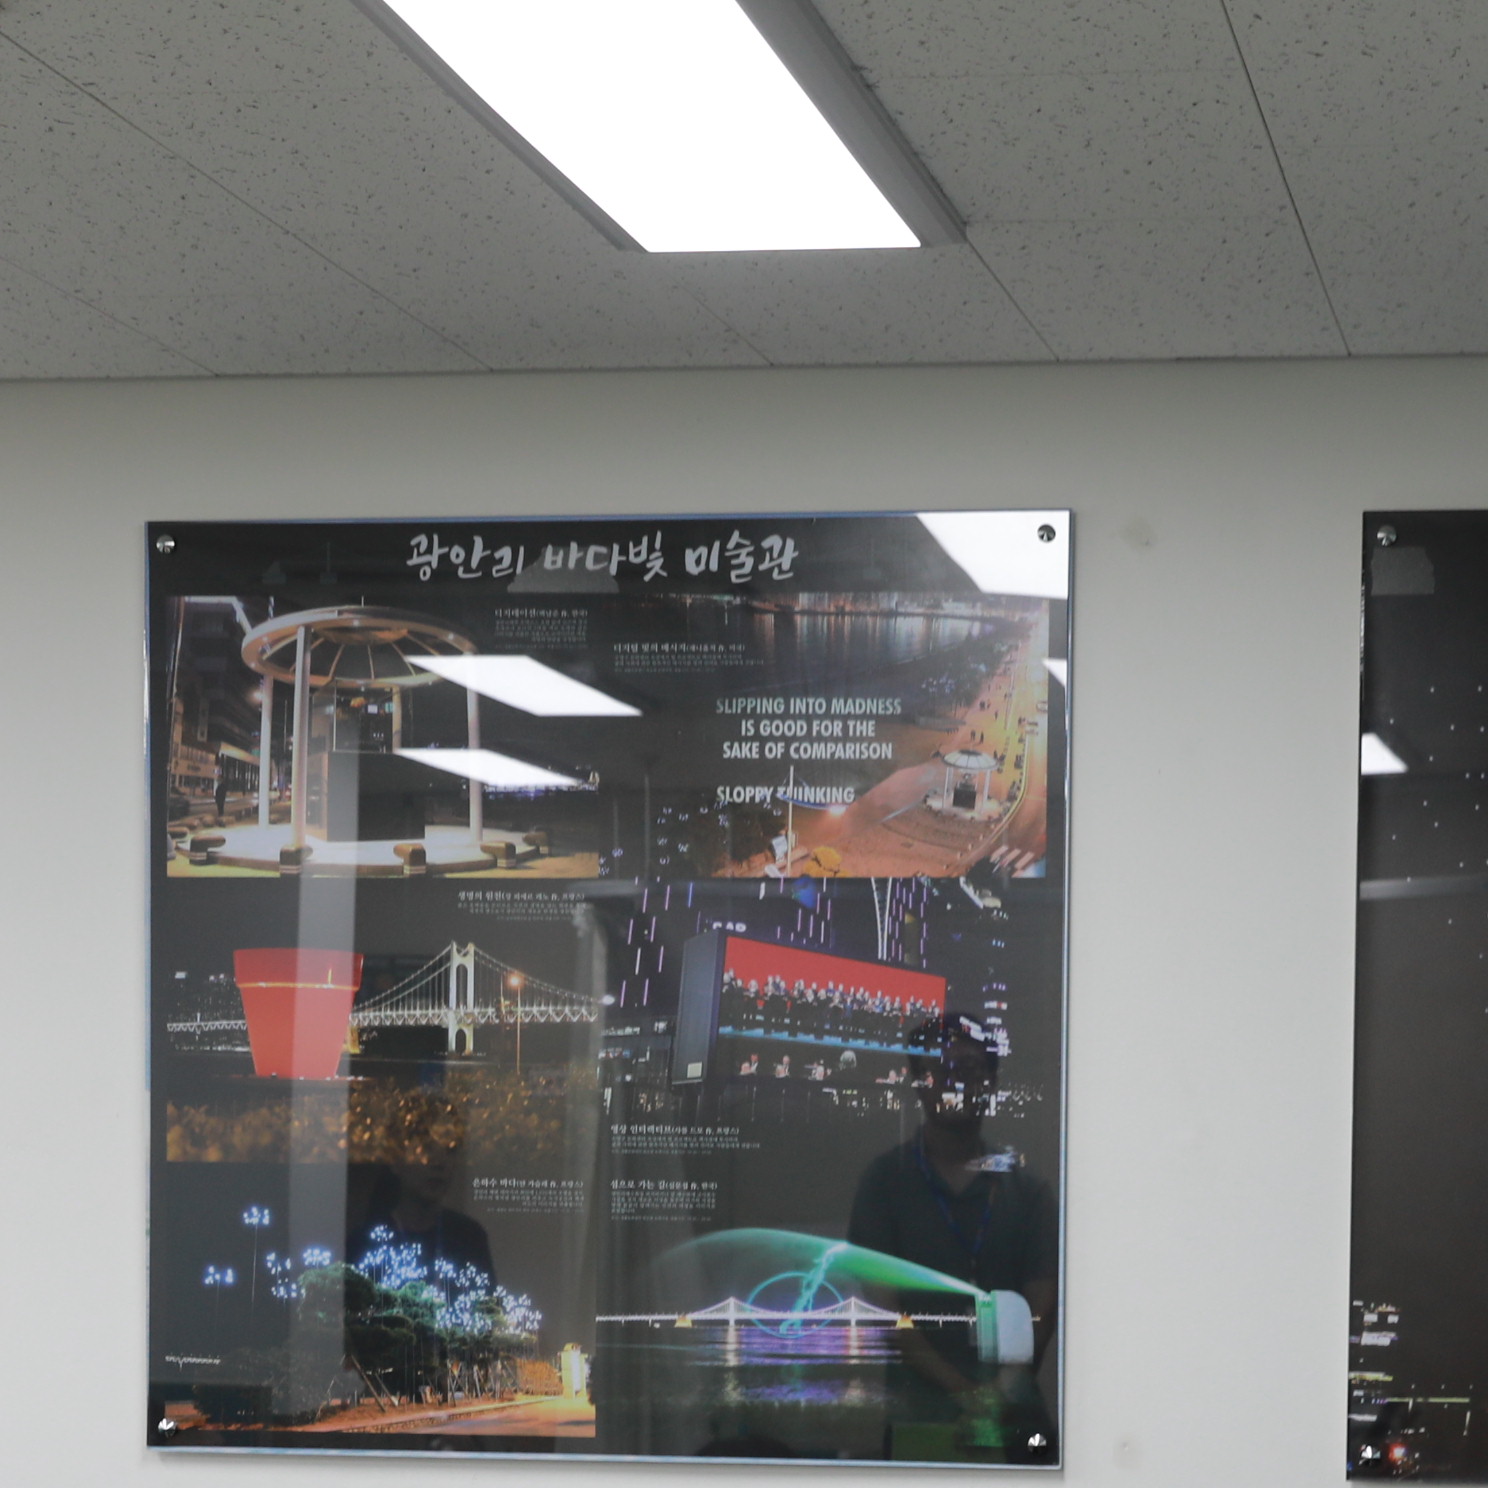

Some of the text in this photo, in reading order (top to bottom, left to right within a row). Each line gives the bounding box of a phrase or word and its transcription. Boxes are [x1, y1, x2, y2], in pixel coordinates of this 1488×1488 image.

[406, 530, 799, 583] 광안리 바다빛 미술관
[716, 697, 902, 715] SLIPPING INTO MADNESS
[741, 719, 876, 737] IS GOOD FOR THE
[722, 741, 893, 759] SAKE OF COMPARISON
[716, 786, 774, 803] SLOPPY
